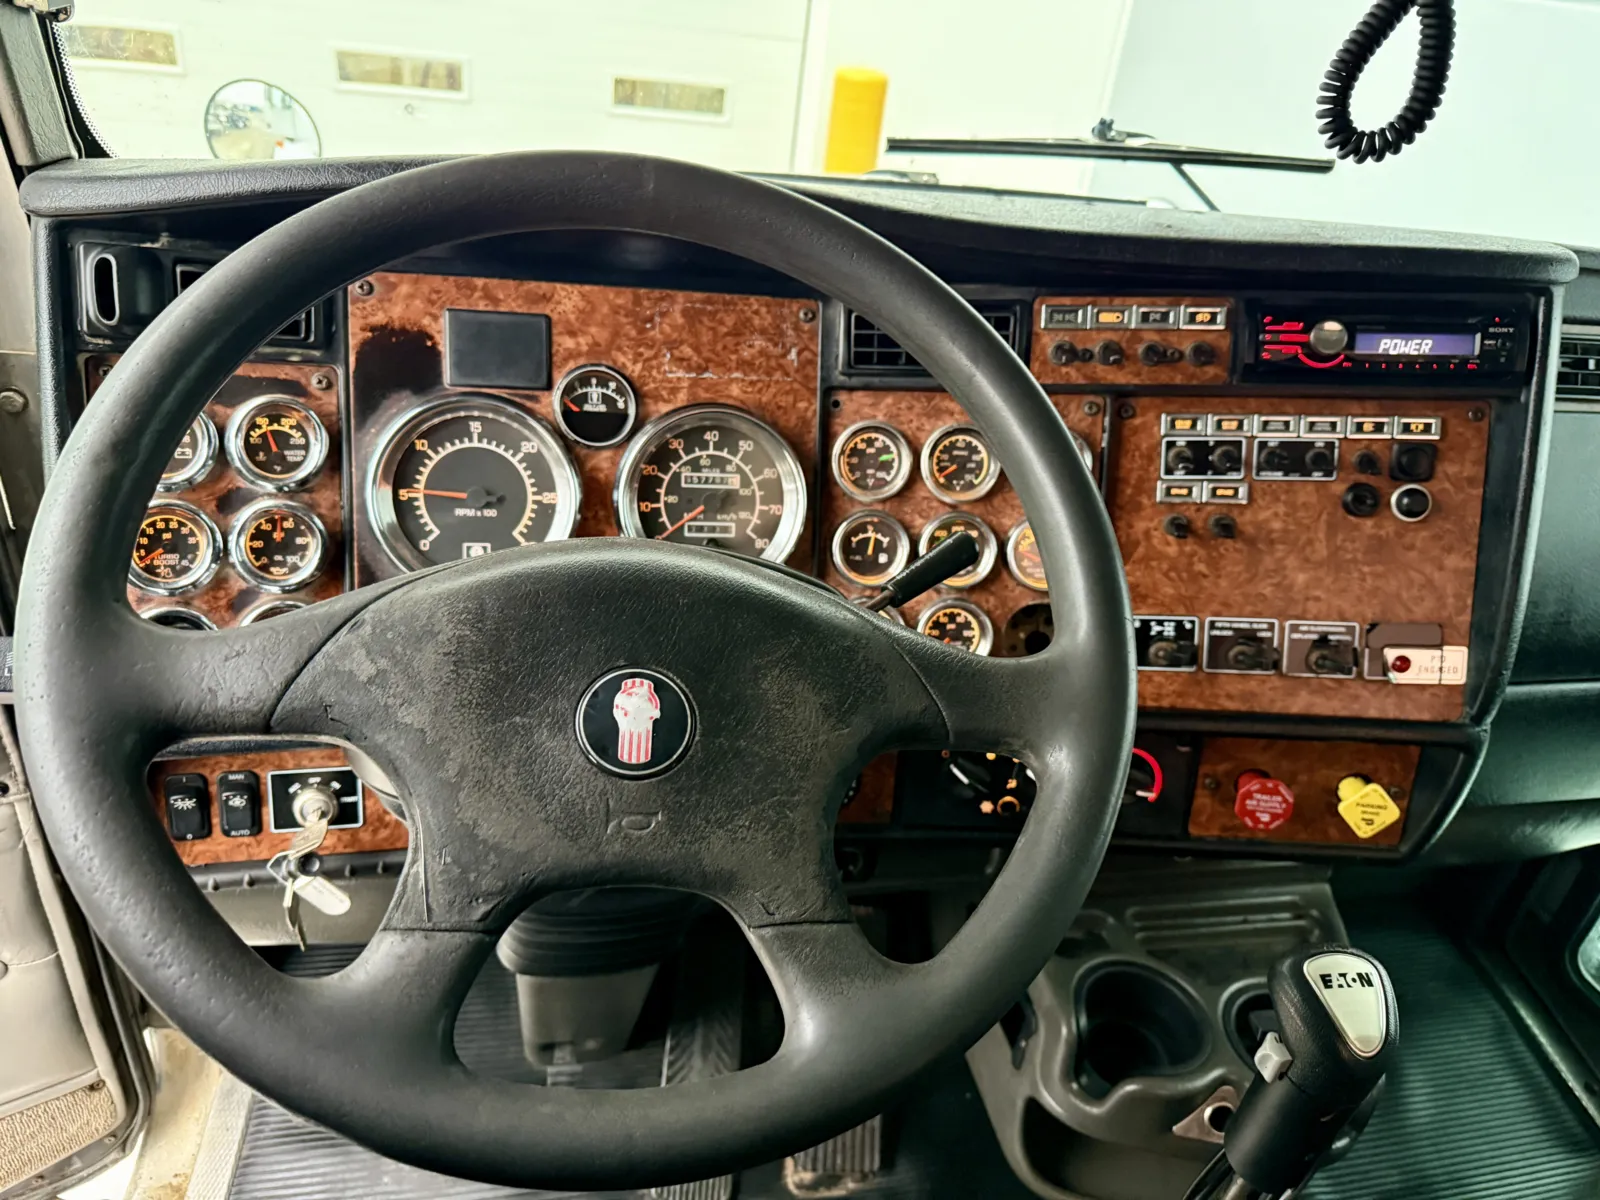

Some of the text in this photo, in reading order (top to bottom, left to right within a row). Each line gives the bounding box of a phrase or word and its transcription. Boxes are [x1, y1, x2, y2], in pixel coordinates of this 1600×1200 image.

[1378, 338, 1433, 355] POWER
[255, 417, 270, 425] 150
[281, 417, 297, 426] 200
[469, 421, 482, 433] 15
[703, 430, 719, 441] 40
[249, 437, 263, 445] 100
[289, 438, 306, 446] 250
[414, 439, 428, 451] 10
[668, 438, 684, 449] 30
[738, 440, 754, 451] 50
[520, 441, 538, 453] 20
[642, 464, 658, 475] 20
[681, 465, 692, 473] 40
[725, 464, 737, 473] 80
[763, 468, 778, 479] 60
[398, 489, 409, 501] 5
[739, 488, 752, 496] 100
[542, 492, 558, 504] 25
[667, 495, 679, 503] 20
[639, 501, 652, 512] 10
[768, 505, 782, 515] 70
[455, 508, 476, 517] RPM
[483, 508, 497, 518] 100
[716, 513, 737, 521] km/h
[156, 521, 166, 529] 20
[169, 521, 179, 529] 25
[260, 523, 272, 531] 40
[146, 527, 154, 535] 15
[162, 532, 172, 540] psi
[140, 537, 149, 545] 10
[187, 537, 197, 545] 35
[295, 537, 308, 545] 80
[419, 538, 430, 551] 0
[754, 539, 770, 549] 80
[1418, 665, 1459, 674] ENGAGED
[1319, 972, 1374, 989] EATON
